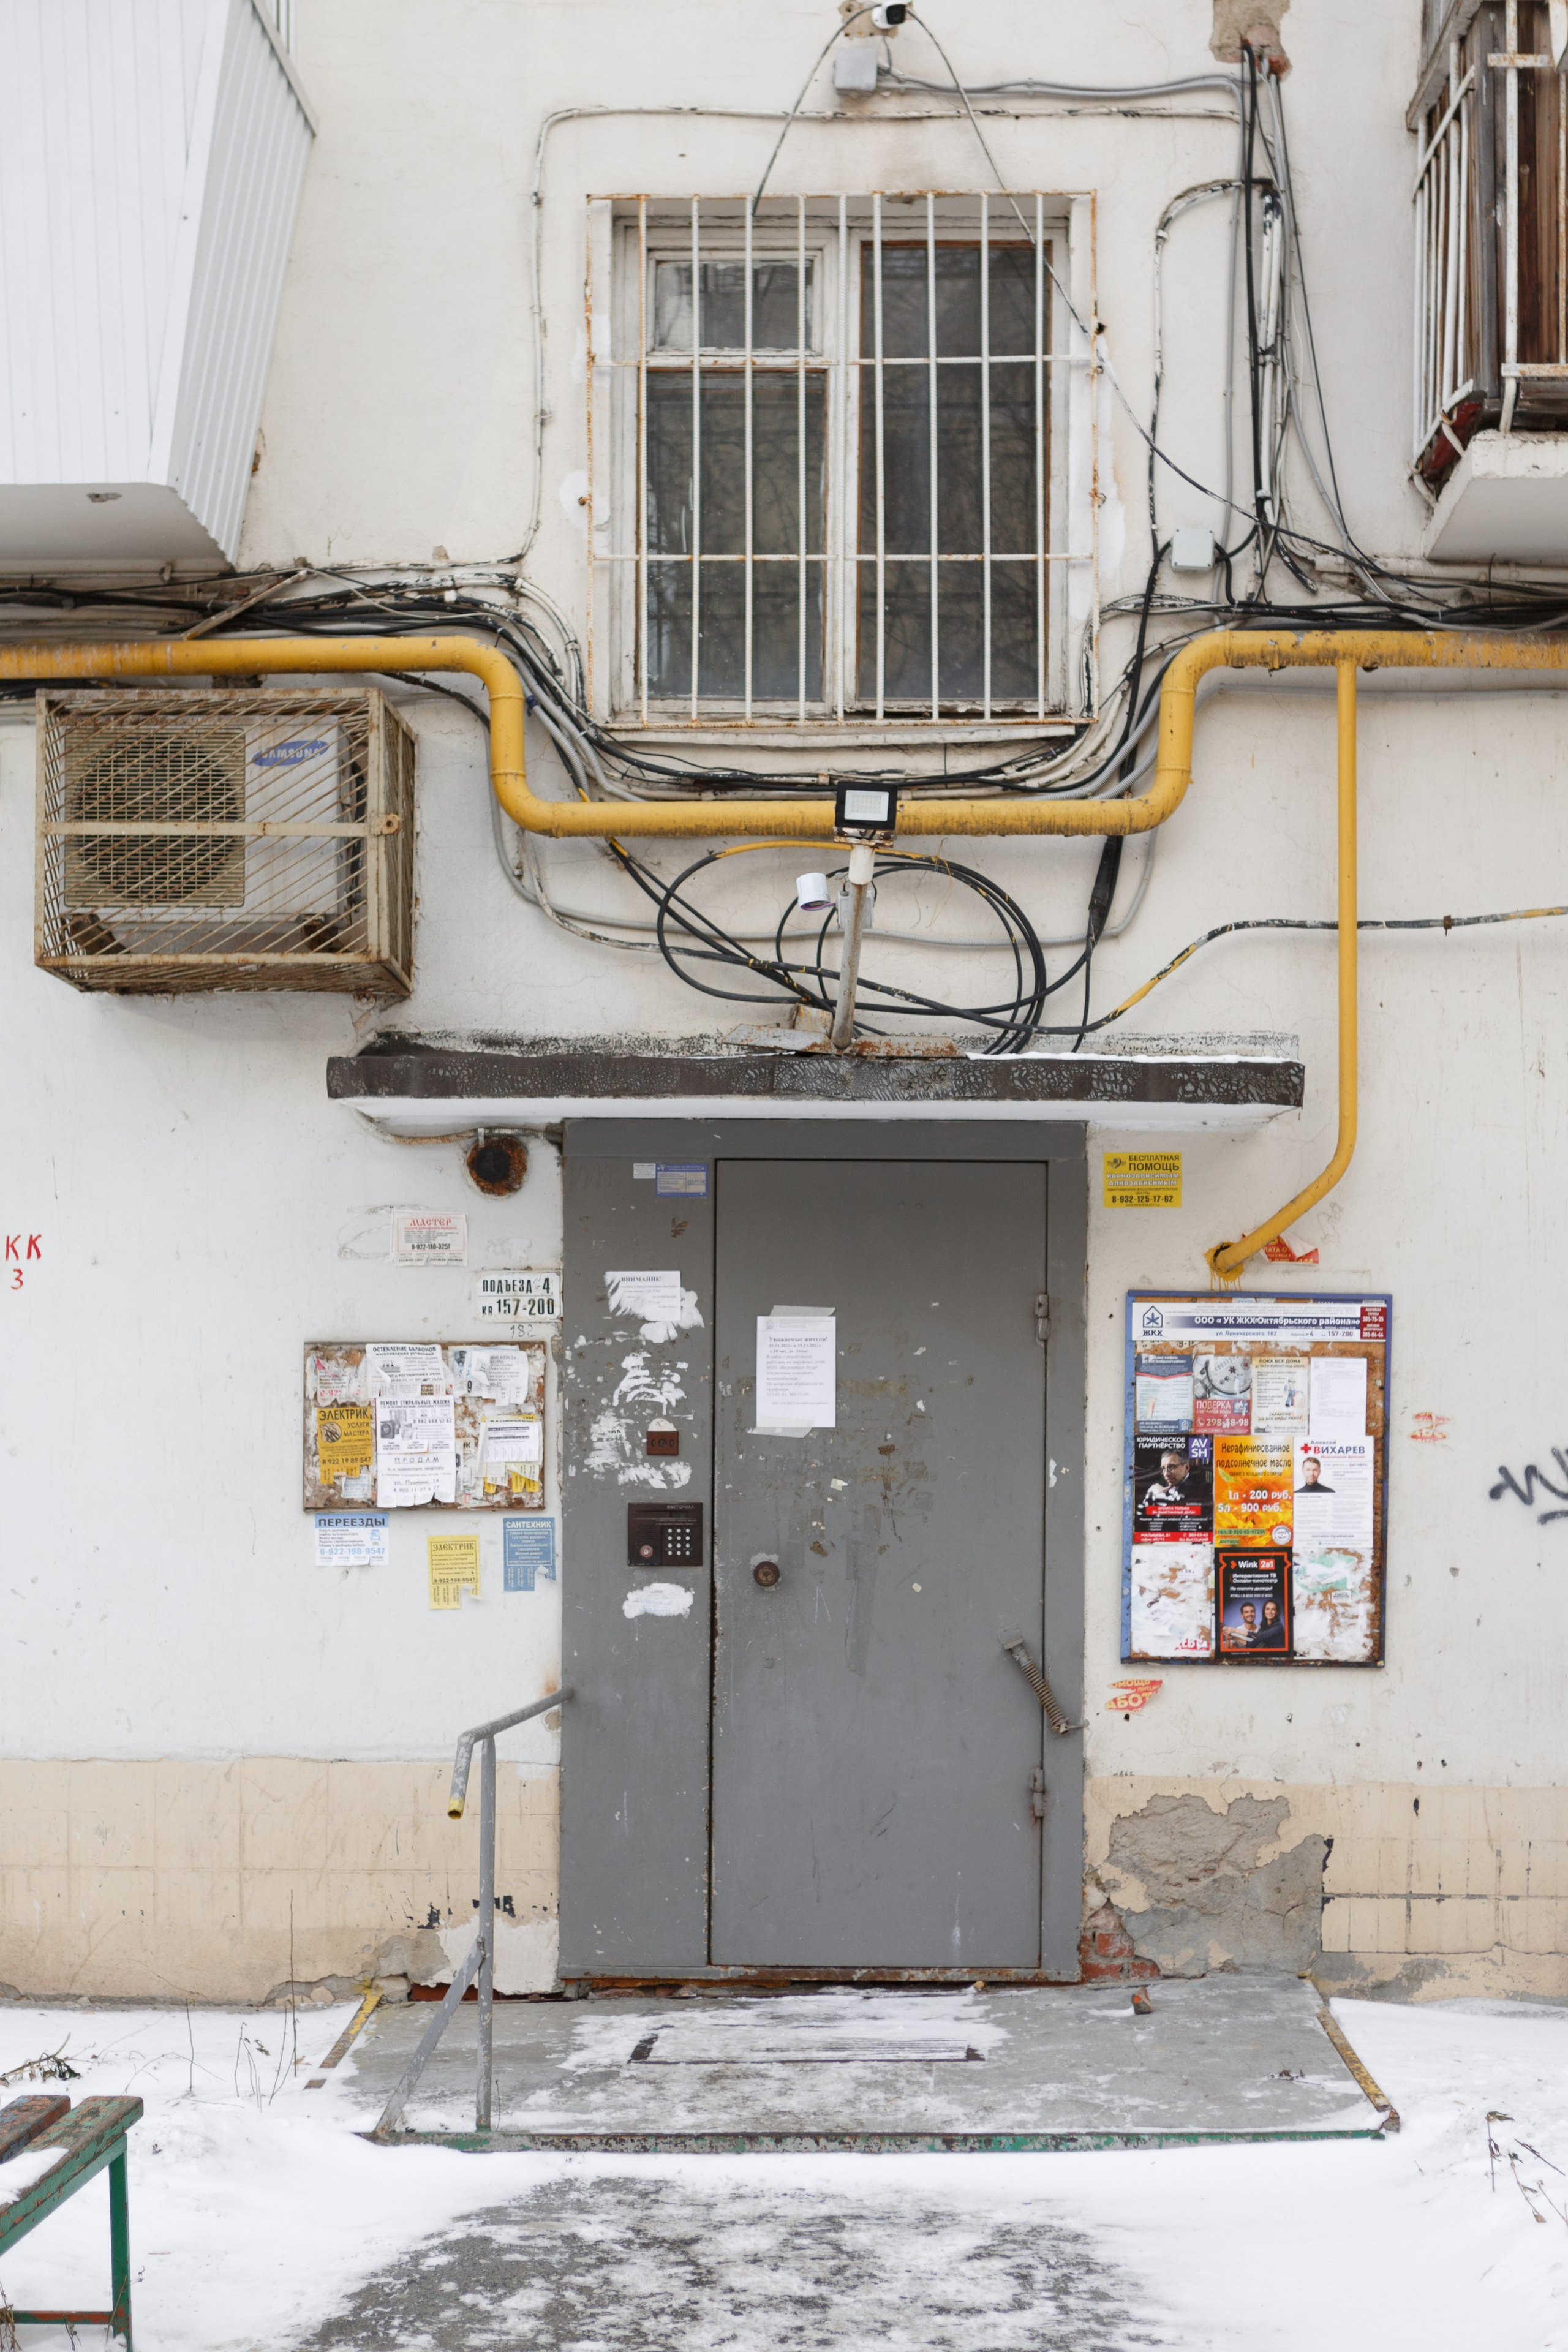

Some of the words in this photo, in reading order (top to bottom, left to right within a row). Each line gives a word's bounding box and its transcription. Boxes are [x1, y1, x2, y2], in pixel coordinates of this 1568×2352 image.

[1129, 1163, 1180, 1172] ПОМОЩЬ
[483, 1280, 532, 1294] ПОДЪЕЗД
[497, 1298, 554, 1316] 157-200
[1258, 1317, 1317, 1327] Октябрьского
[510, 1324, 536, 1340] 182
[1196, 1401, 1231, 1409] ПОВЕРКА
[319, 1408, 369, 1421] ЭЛЕКТРИК
[1191, 1438, 1208, 1448] AV
[1191, 1448, 1207, 1458] SH
[1221, 1443, 1290, 1454] Нерафинированное
[1216, 1459, 1267, 1468] подсолнечное
[1270, 1458, 1291, 1467] масло
[1250, 1490, 1268, 1499] 200
[1271, 1490, 1292, 1500] руб.
[1218, 1503, 1231, 1512] 5л
[1241, 1503, 1259, 1512] 900
[1262, 1502, 1283, 1512] руб.
[318, 1518, 385, 1528] ПЕРЕЕЗДЫ
[433, 1543, 475, 1551] ЭЛЕКТРИК
